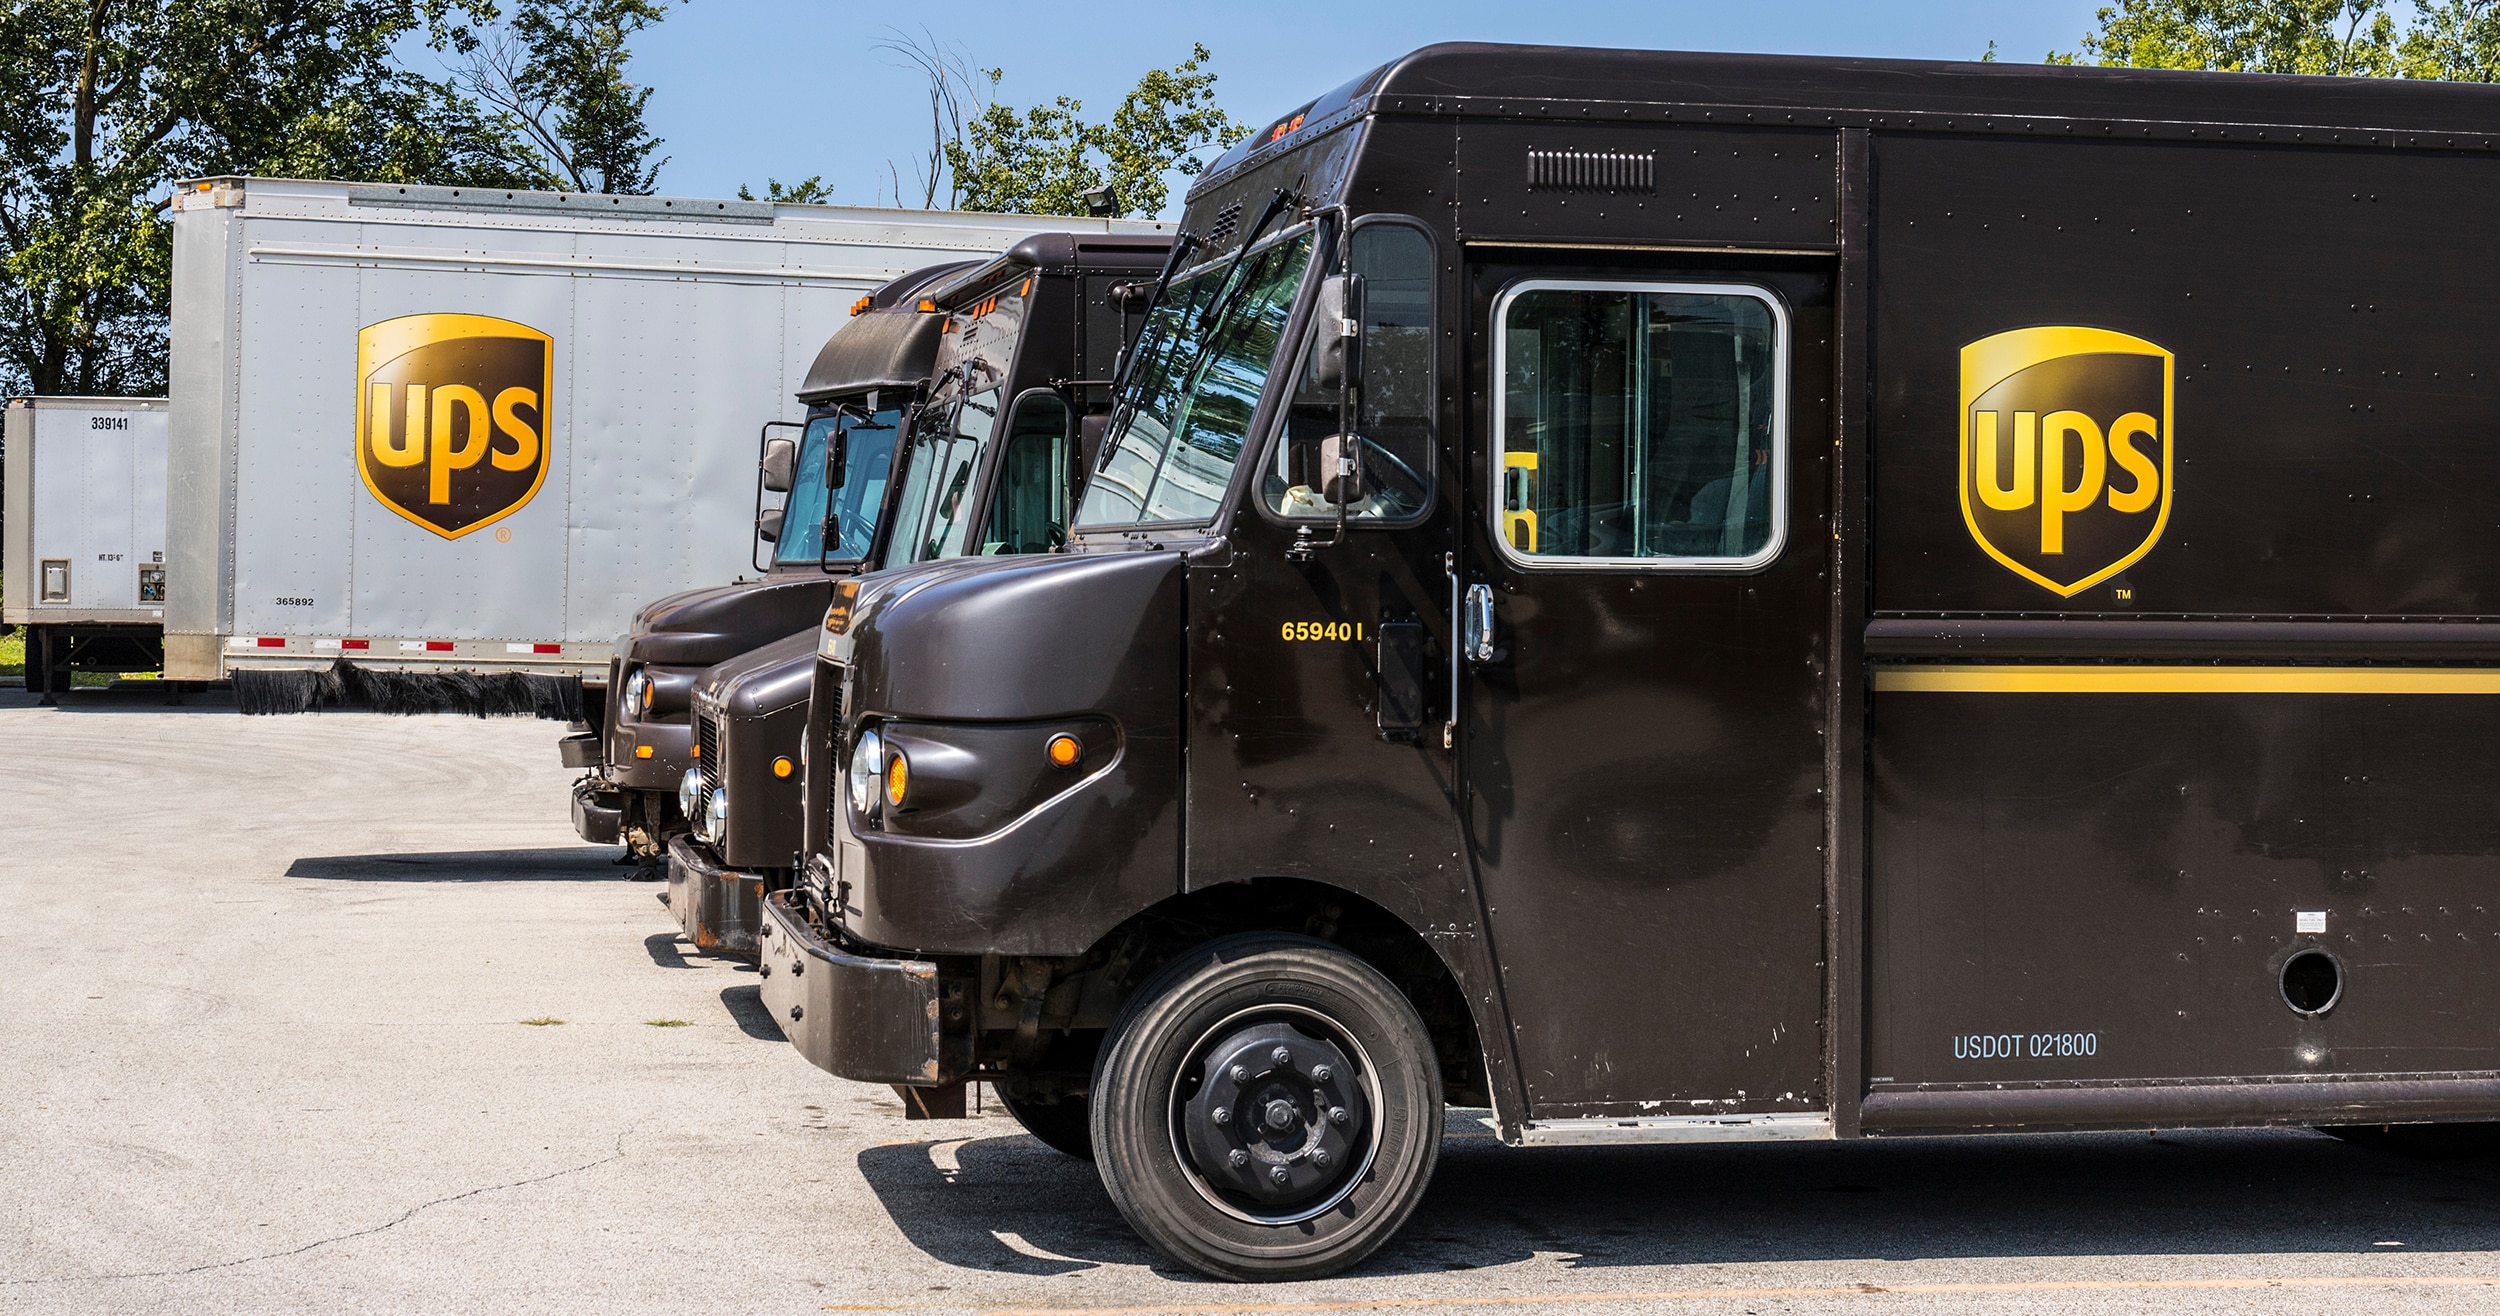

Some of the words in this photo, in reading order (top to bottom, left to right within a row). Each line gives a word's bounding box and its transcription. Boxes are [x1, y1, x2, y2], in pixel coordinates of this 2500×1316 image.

[91, 417, 128, 430] 339141
[371, 382, 538, 505] ups
[1975, 409, 2160, 555] ups
[275, 597, 314, 607] 365892
[2116, 589, 2132, 599] TM
[1281, 621, 1363, 641] 659401
[1954, 1034, 2024, 1059] USDOT
[2029, 1032, 2097, 1057] 021800
[1350, 1106, 1407, 1214] BRIDGESTON
